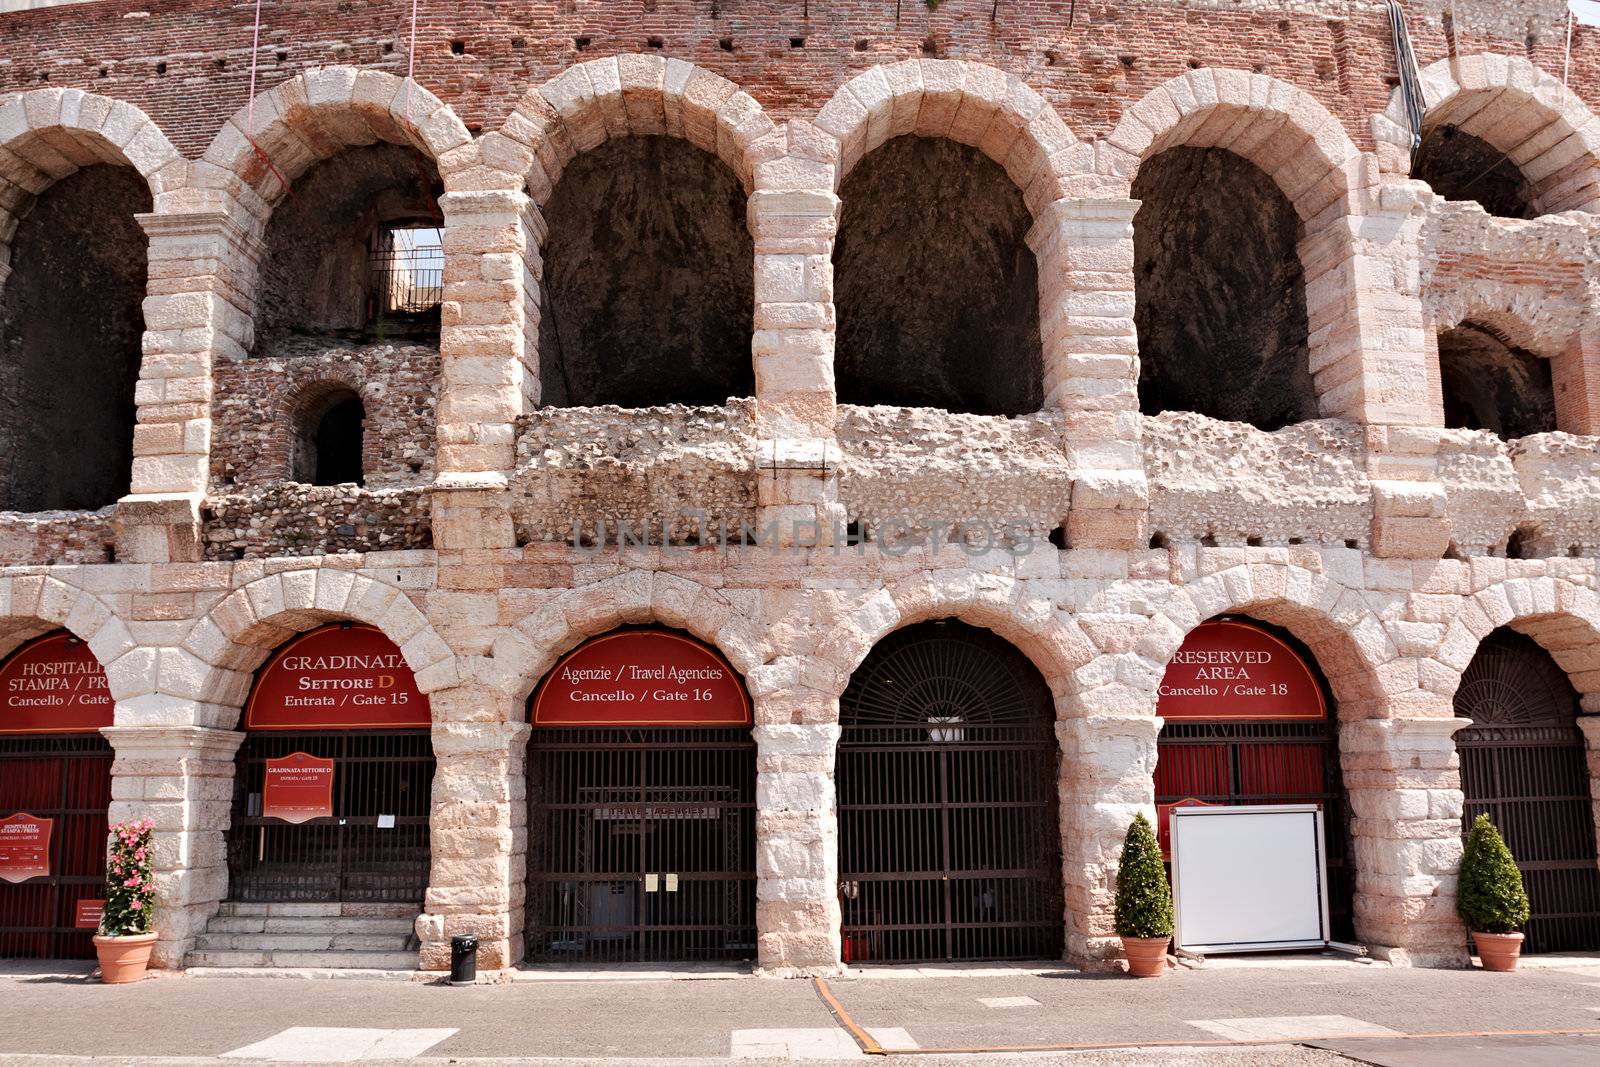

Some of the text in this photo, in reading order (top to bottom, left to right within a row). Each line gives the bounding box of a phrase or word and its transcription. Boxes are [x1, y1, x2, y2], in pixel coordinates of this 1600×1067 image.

[283, 654, 409, 670] GRADINATA
[1171, 651, 1271, 664] RESERVED
[561, 665, 722, 684] Agenzie / Travel Agencies
[1195, 667, 1250, 680] AREA
[9, 678, 70, 691] STAMPA
[74, 677, 84, 691] /
[379, 675, 394, 688] D
[570, 688, 712, 702] Cancello / Gate 16
[1159, 683, 1288, 696] Cancello / Gate 18
[8, 693, 110, 706] Cancello / Gate
[284, 692, 408, 707] Entrata / Gate 15
